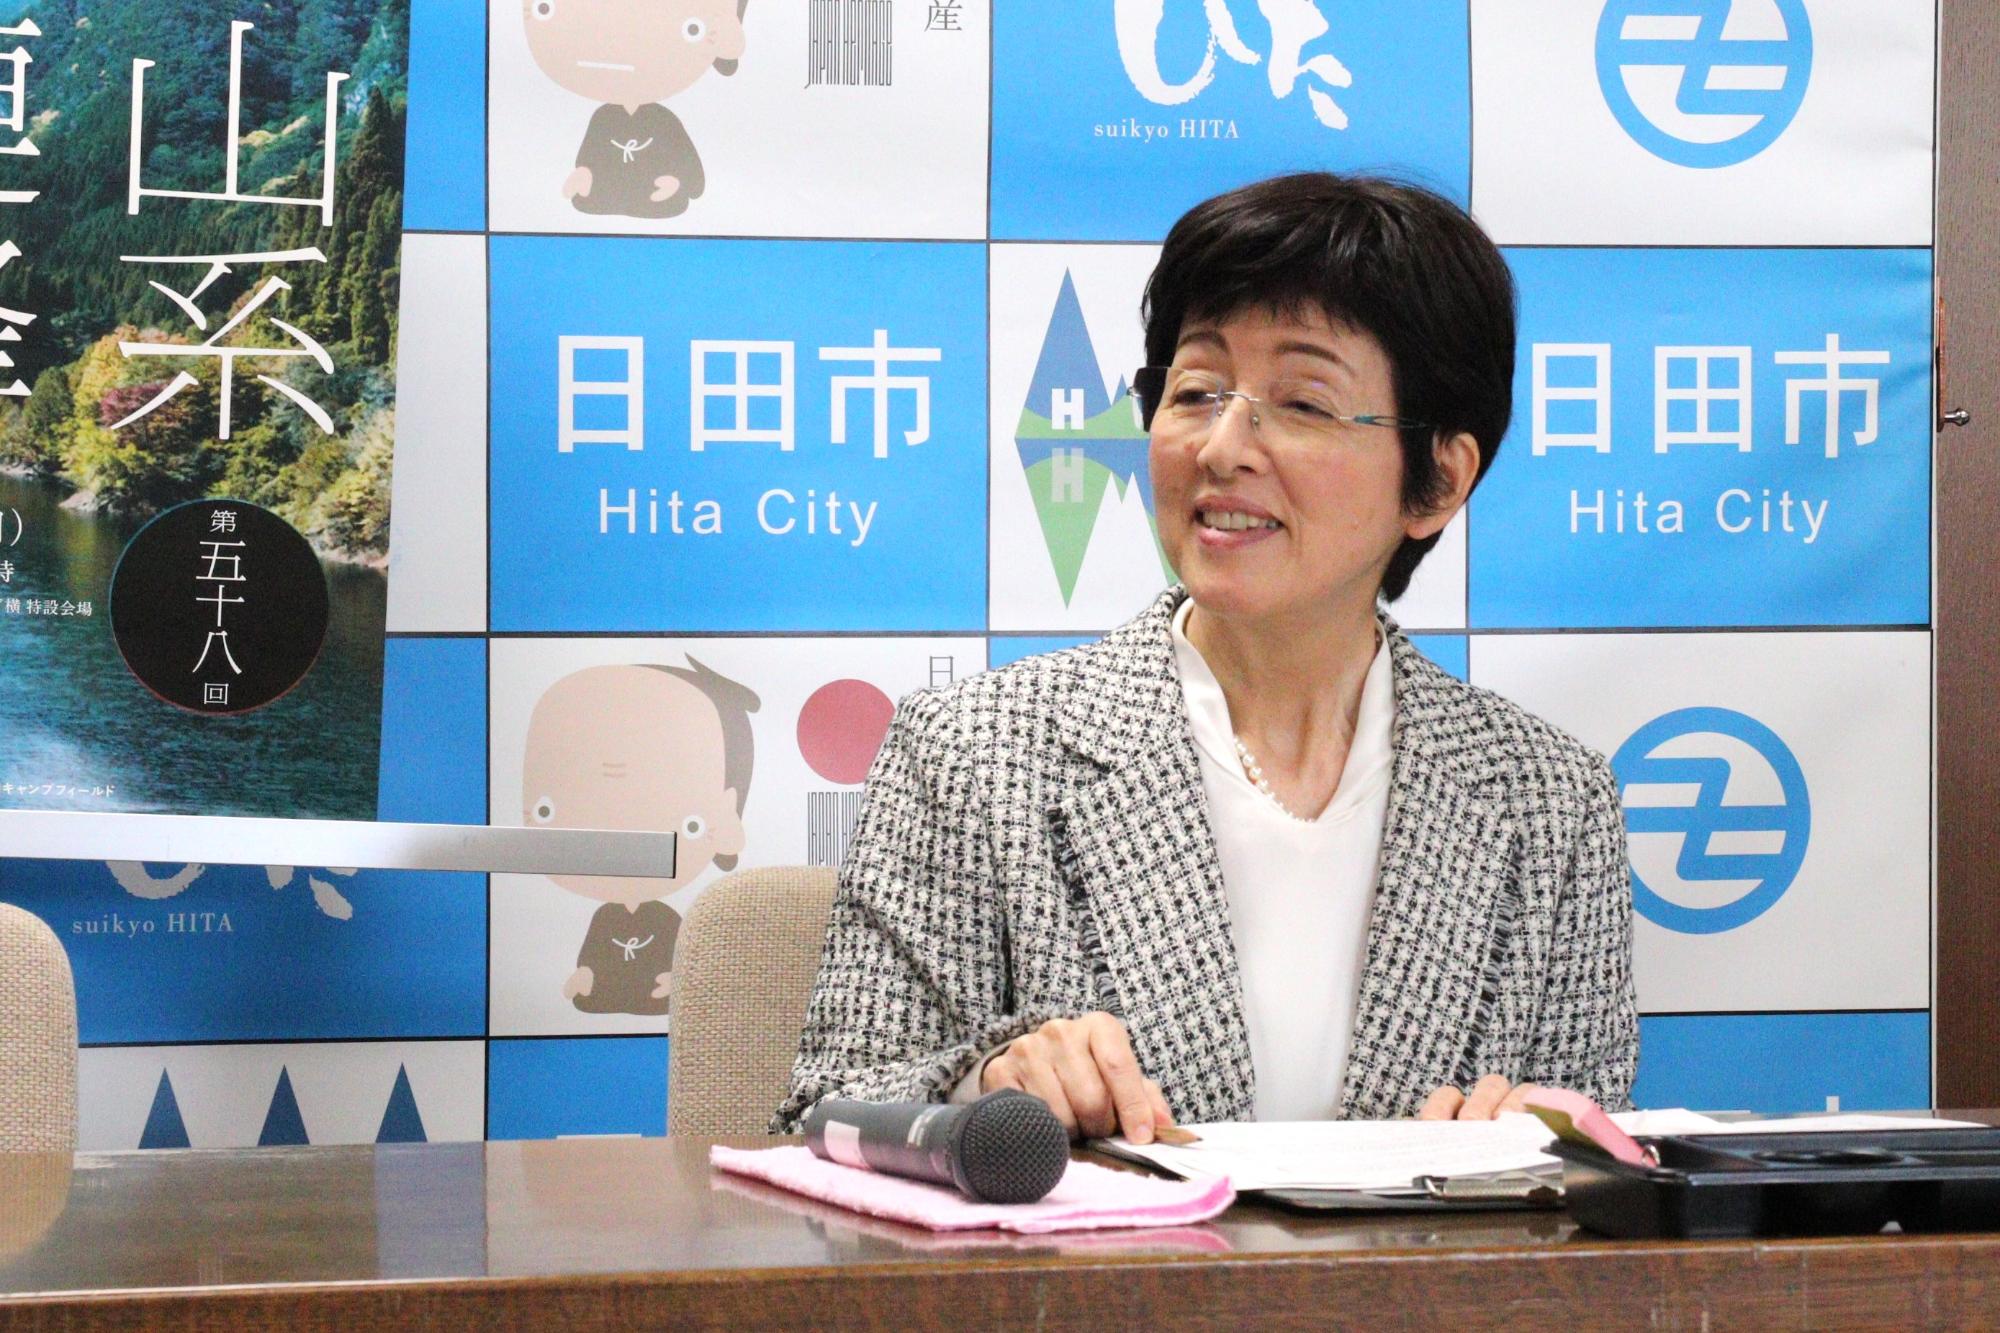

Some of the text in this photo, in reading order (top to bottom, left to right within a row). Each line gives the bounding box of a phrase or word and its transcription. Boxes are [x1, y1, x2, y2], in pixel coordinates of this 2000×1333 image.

[1094, 118, 1240, 143] suikyo HITA
[558, 329, 942, 459] 日田市
[1532, 333, 1890, 458] 日田市
[600, 488, 878, 547] Hita City
[1570, 488, 1828, 544] Hita City
[26, 599, 92, 617] 特設会場
[192, 509, 247, 705] 第五十八回
[72, 912, 233, 938] suikyo HITA
